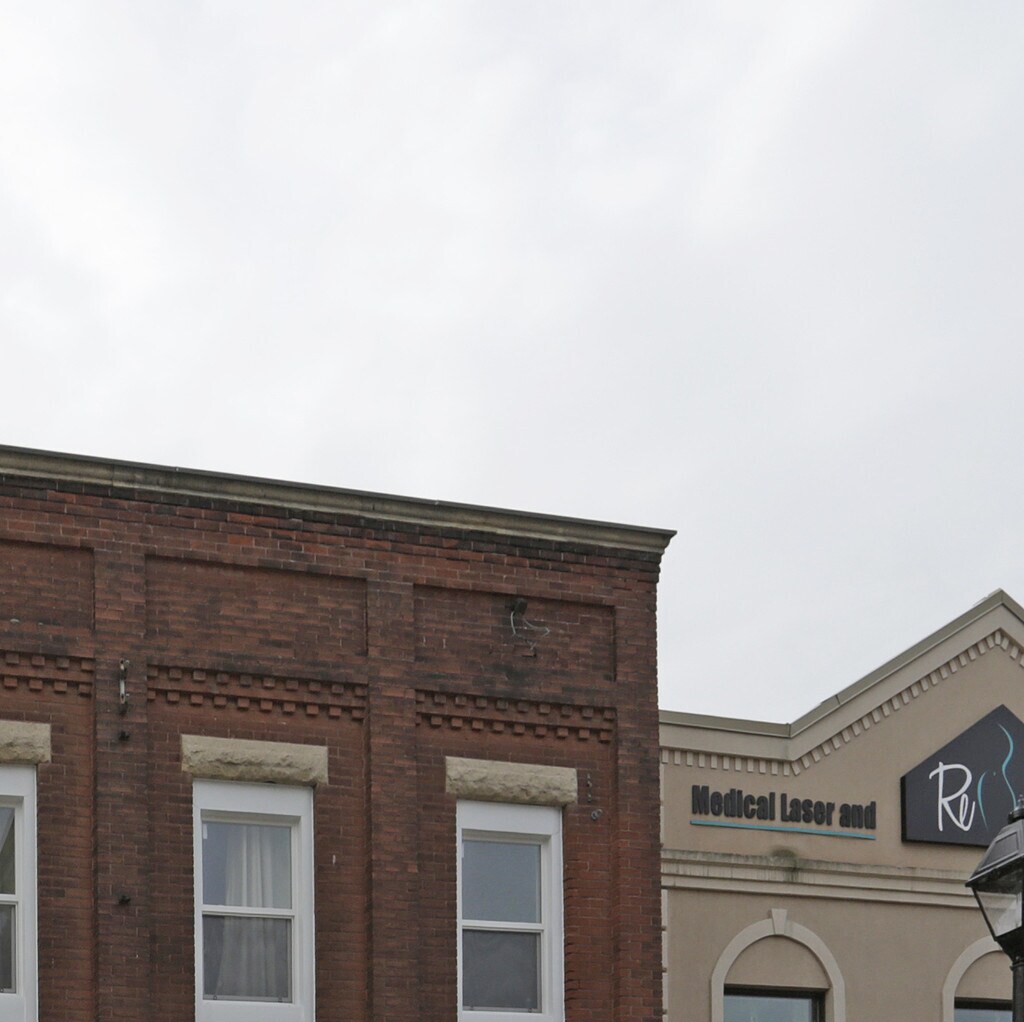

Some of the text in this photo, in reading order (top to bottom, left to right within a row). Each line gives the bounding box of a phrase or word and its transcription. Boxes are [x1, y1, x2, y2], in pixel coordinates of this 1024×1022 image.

[692, 785, 876, 829] Medical Laser and
